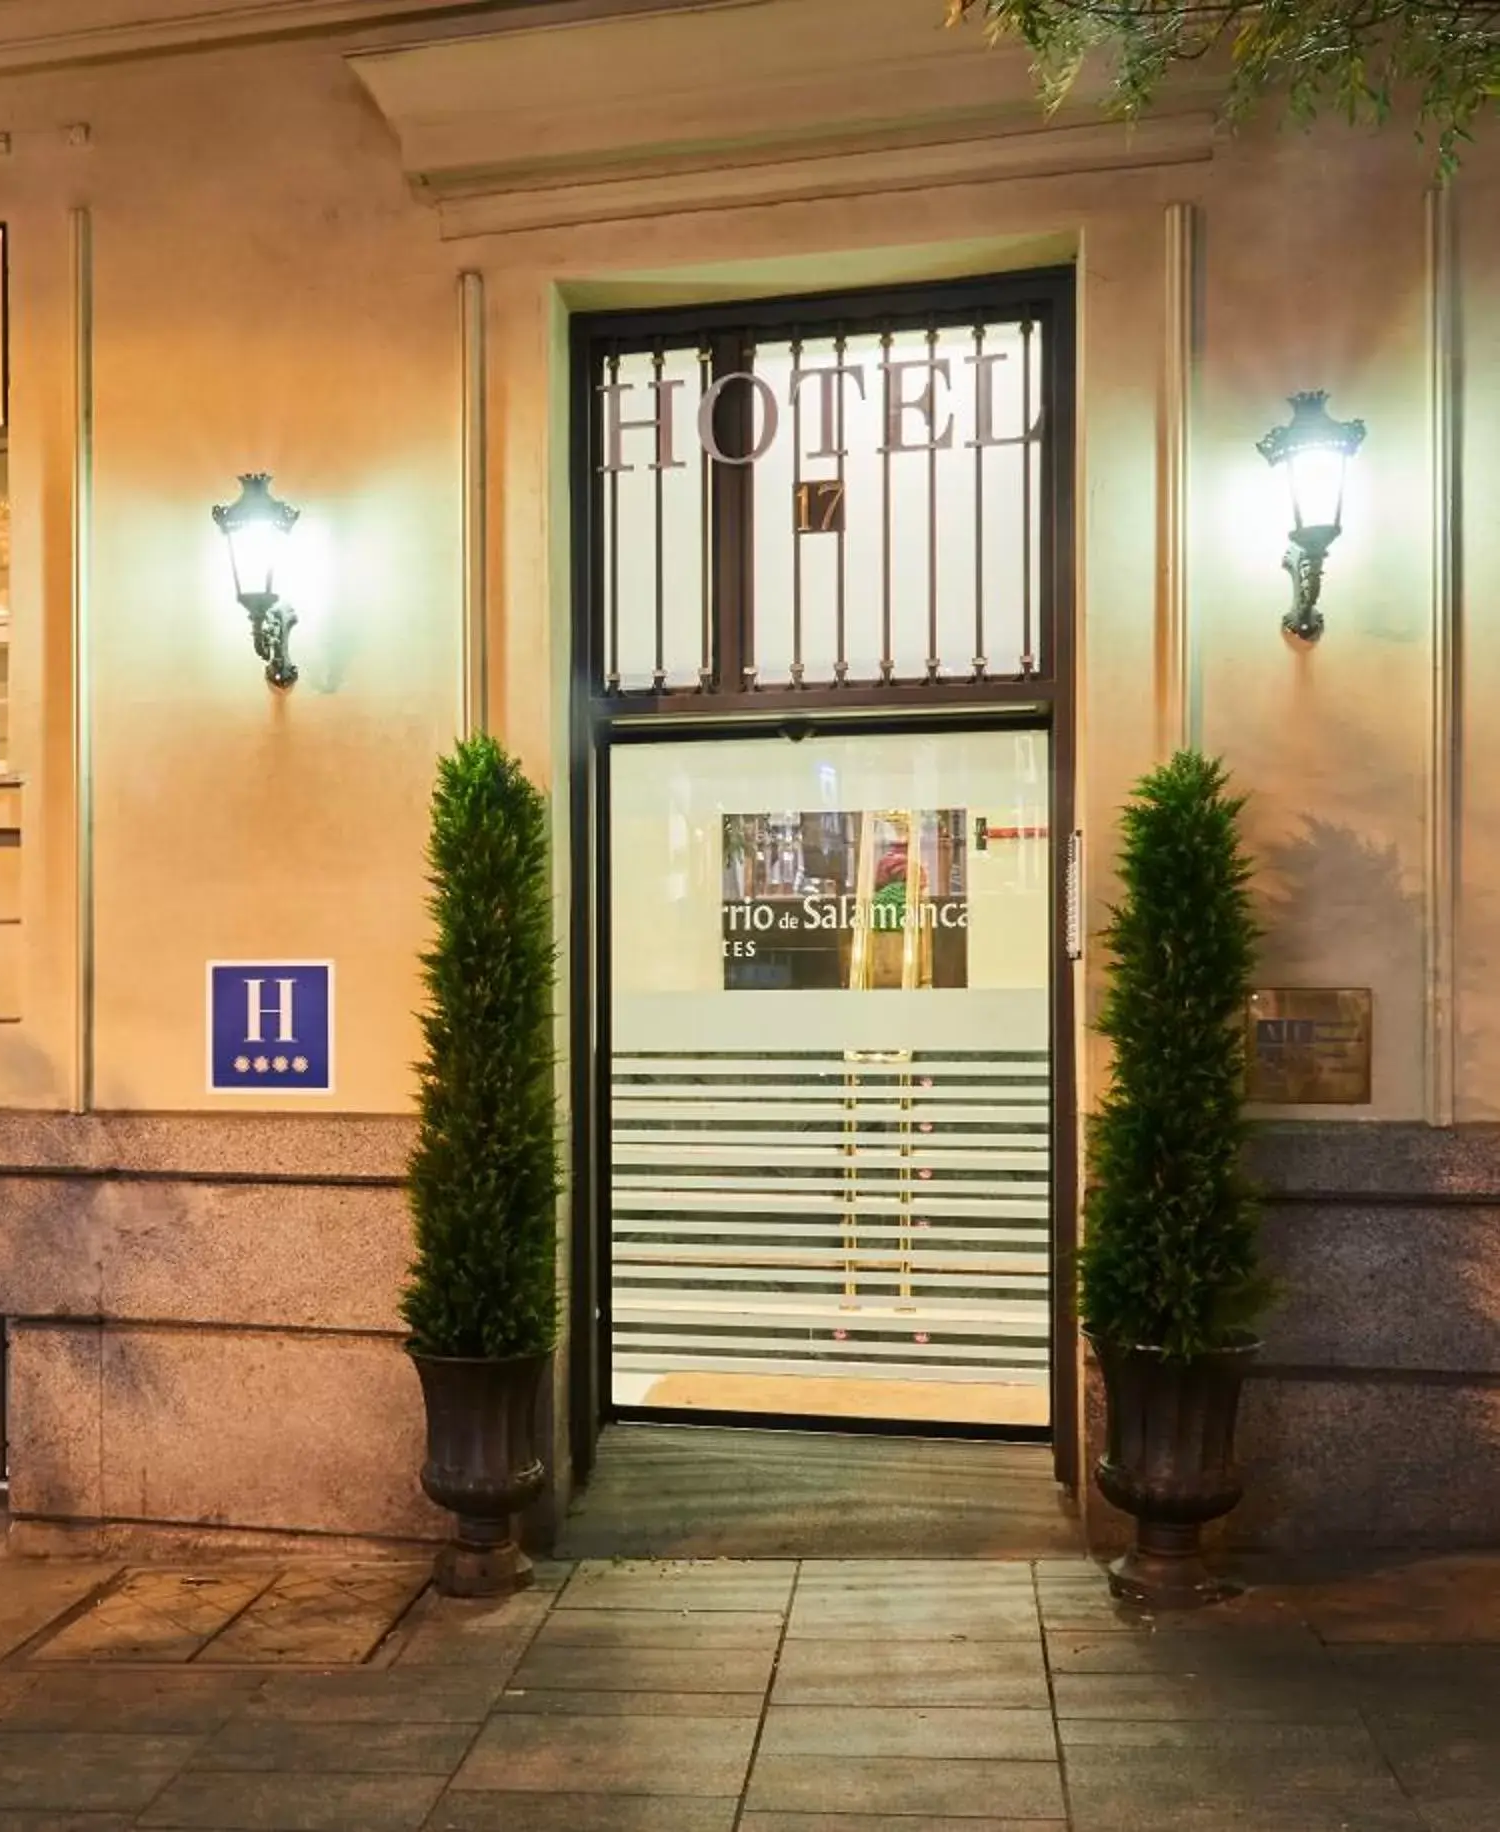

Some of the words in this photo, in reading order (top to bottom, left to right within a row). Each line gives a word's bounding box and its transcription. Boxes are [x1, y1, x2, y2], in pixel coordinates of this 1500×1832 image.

[596, 351, 1046, 474] HOTEL
[795, 482, 843, 531] 17
[778, 911, 800, 930] de
[803, 893, 969, 930] Salamanca
[243, 979, 299, 1043] H
